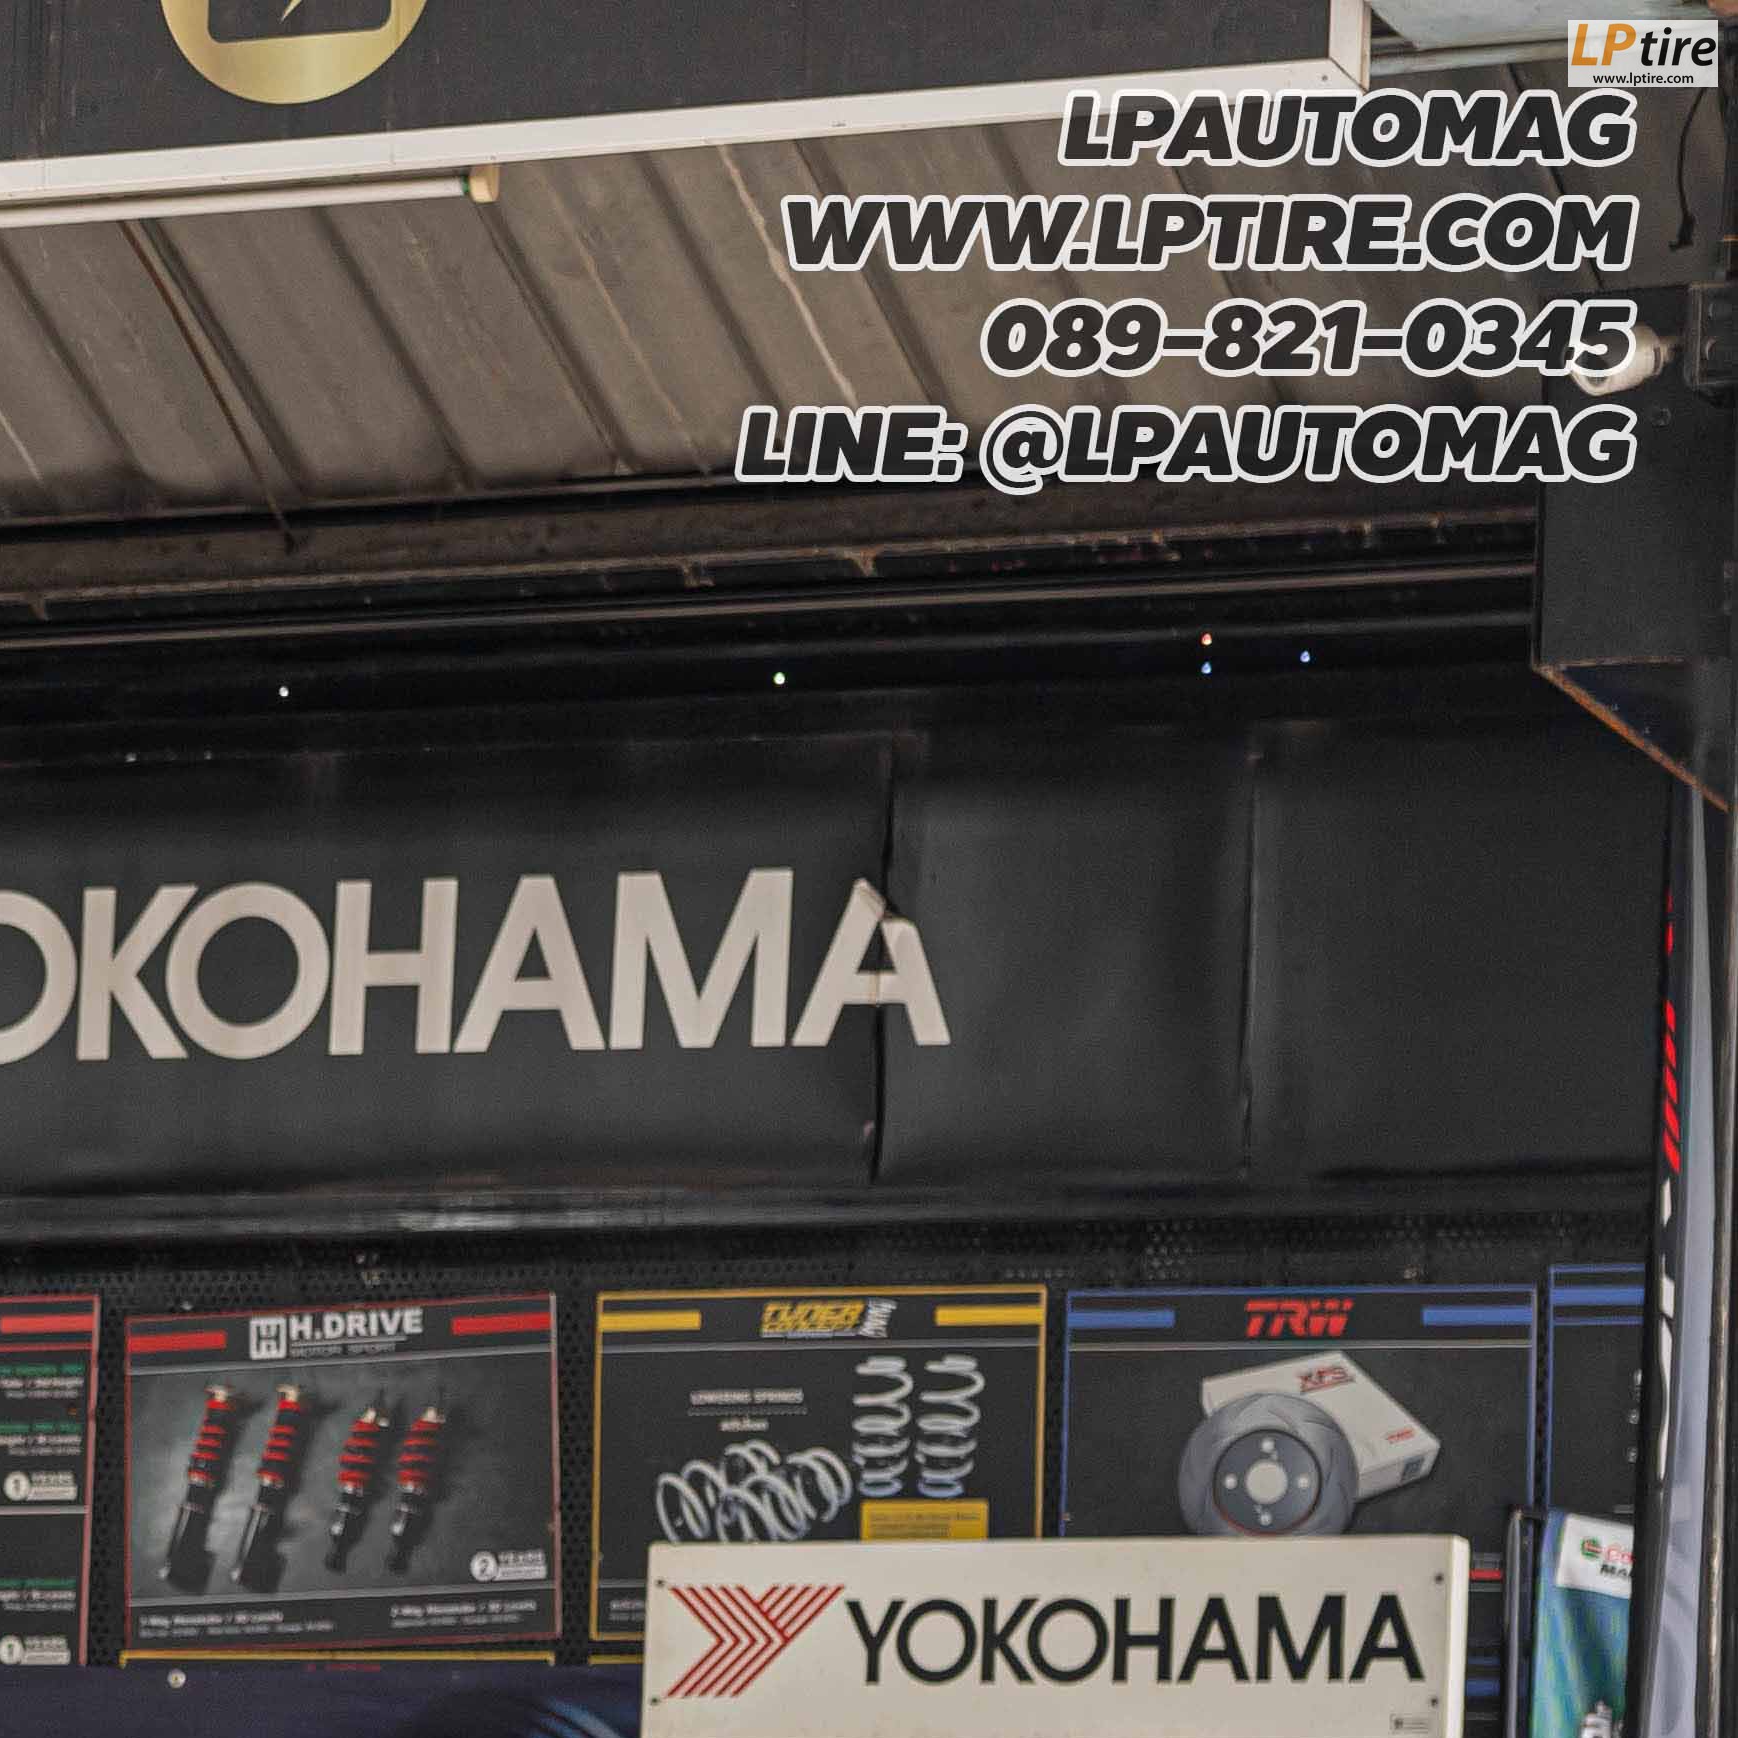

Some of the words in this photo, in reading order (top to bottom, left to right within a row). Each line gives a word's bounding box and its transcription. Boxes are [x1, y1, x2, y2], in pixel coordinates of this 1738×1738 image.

[289, 1306, 424, 1342] H.DRIVE
[1245, 1298, 1355, 1338] TRW
[846, 1594, 1425, 1683] YOKOHAMA
